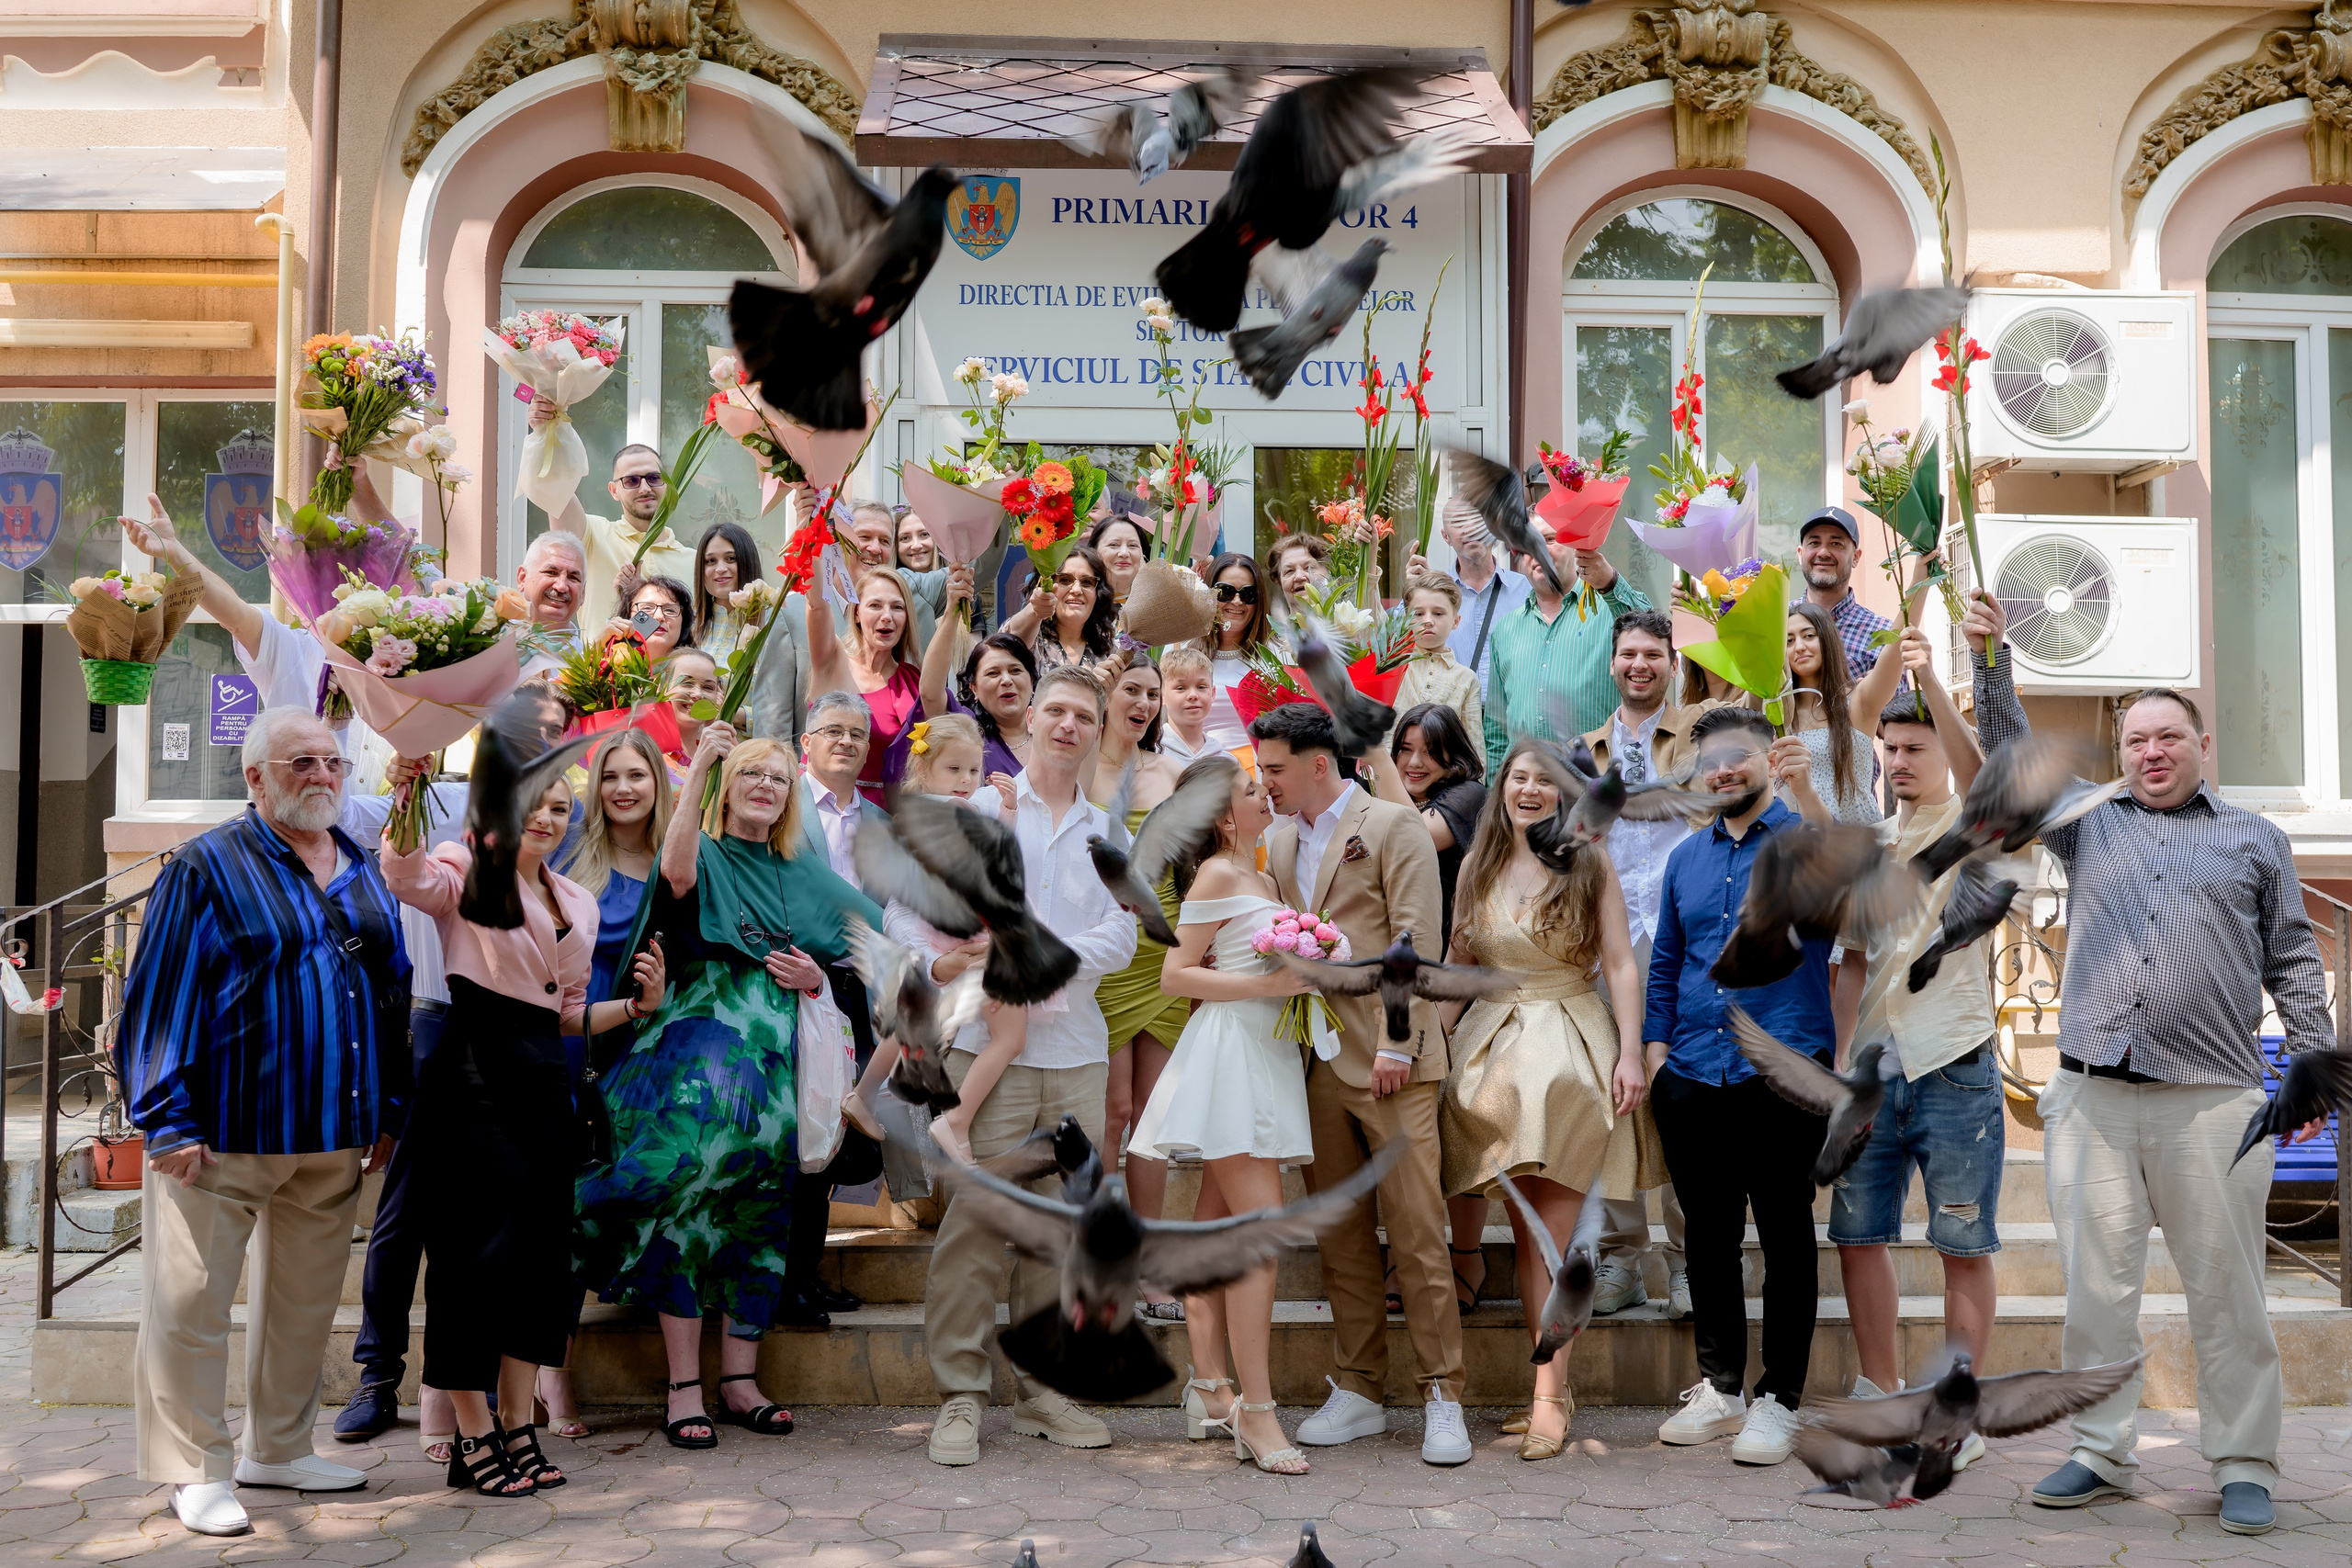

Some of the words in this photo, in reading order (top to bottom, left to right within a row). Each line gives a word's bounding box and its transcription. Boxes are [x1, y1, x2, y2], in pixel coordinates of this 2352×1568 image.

[1051, 197, 1211, 225] PRIMARI
[1400, 204, 1419, 229] 4
[958, 283, 1069, 307] DIRECTIA
[1074, 286, 1107, 307] DE
[961, 355, 1130, 385] ERVICIUL
[1137, 357, 1184, 385] DE
